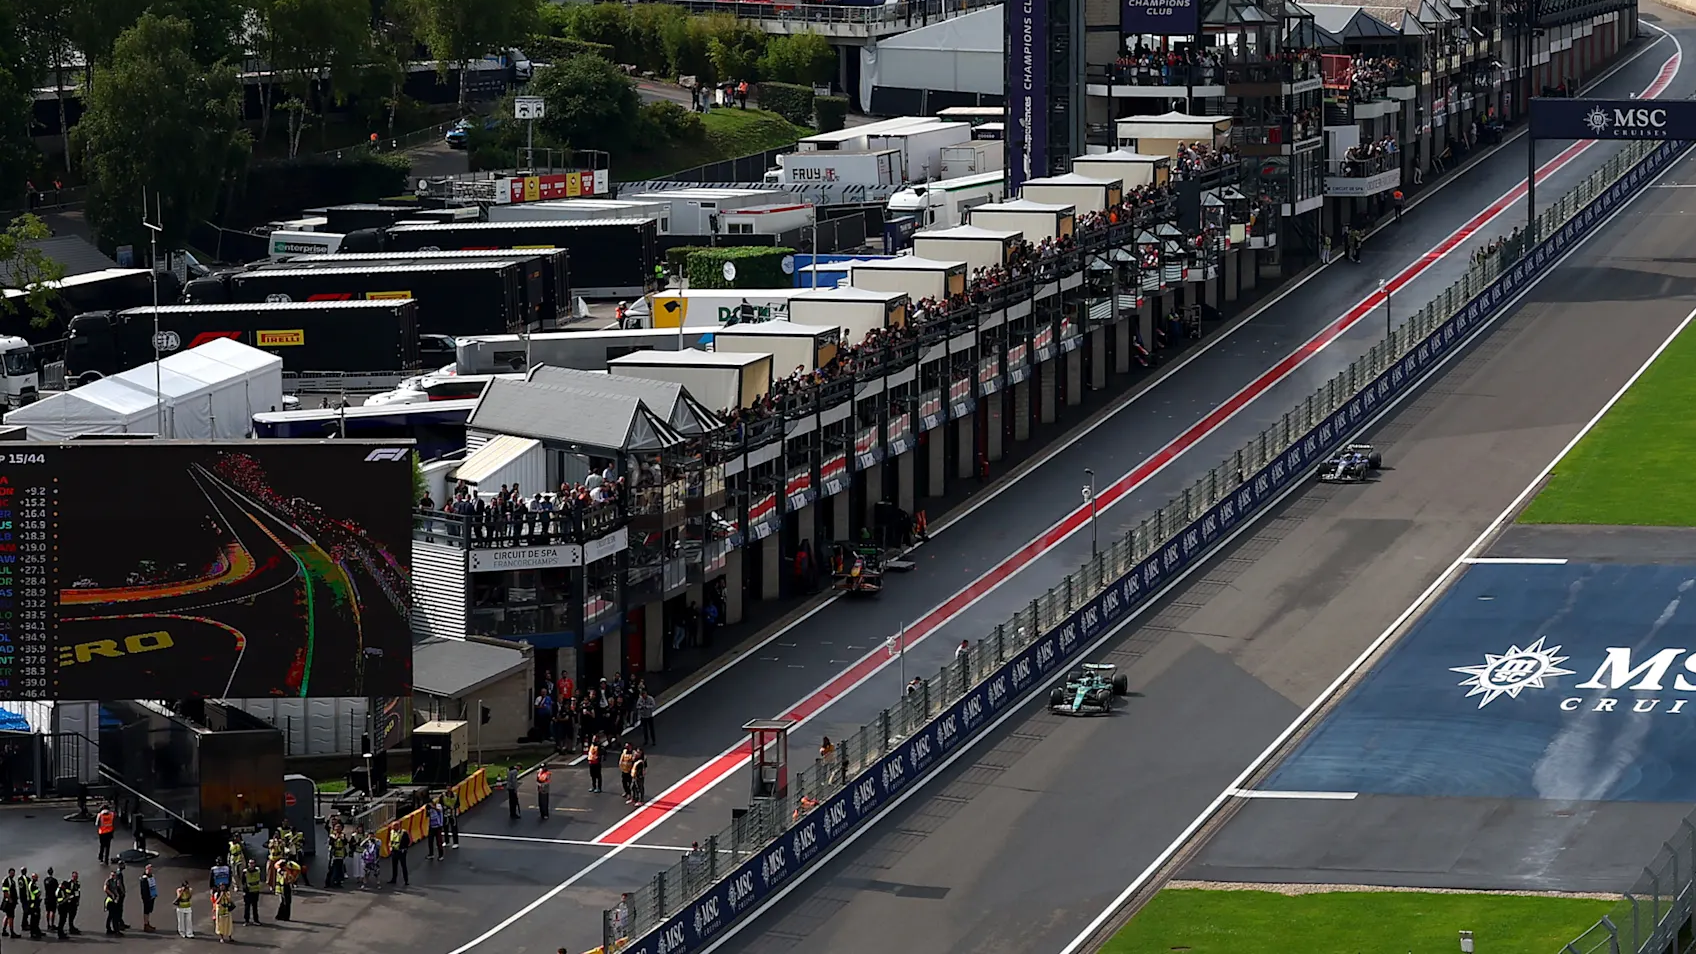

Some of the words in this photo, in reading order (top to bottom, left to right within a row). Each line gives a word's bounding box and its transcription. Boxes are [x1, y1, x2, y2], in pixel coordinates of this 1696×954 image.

[1128, 0, 1191, 7] CHAMPIONS
[1146, 7, 1173, 15] CLUB
[1023, 17, 1032, 91] CHAMPIONS
[1613, 108, 1667, 127] MSC
[1613, 129, 1667, 137] CRUISES
[792, 168, 821, 180] FRUY
[261, 333, 300, 343] PIRELLI
[9, 454, 46, 464] 15/44
[25, 486, 46, 496] +9.2
[20, 498, 46, 507] +15.2
[20, 509, 46, 518] +16.4
[20, 520, 46, 530] +16.9
[20, 532, 46, 540] +18.3
[20, 543, 46, 552] +19.0
[20, 554, 46, 563] +26.5
[493, 550, 525, 560] CIRCUIT
[527, 550, 540, 559] DE
[541, 549, 558, 558] SPA
[493, 558, 559, 568] FRANCORCHAMPS
[20, 566, 46, 574] +27.1
[20, 576, 46, 586] +28.4
[20, 588, 46, 597] +28.9
[20, 610, 46, 620] +33.5
[20, 622, 46, 630] +34.1
[20, 633, 46, 642] +34.9
[20, 656, 46, 664] +37.6
[20, 666, 46, 676] +38.3
[20, 678, 46, 687] +39.0
[888, 755, 904, 782] MSC
[860, 777, 876, 804] MSC
[830, 799, 846, 827] MSC
[800, 822, 816, 850] MSC
[768, 846, 786, 876] MSC
[735, 871, 753, 901] MSC
[700, 896, 719, 927] MSC
[665, 921, 685, 953] MSC
